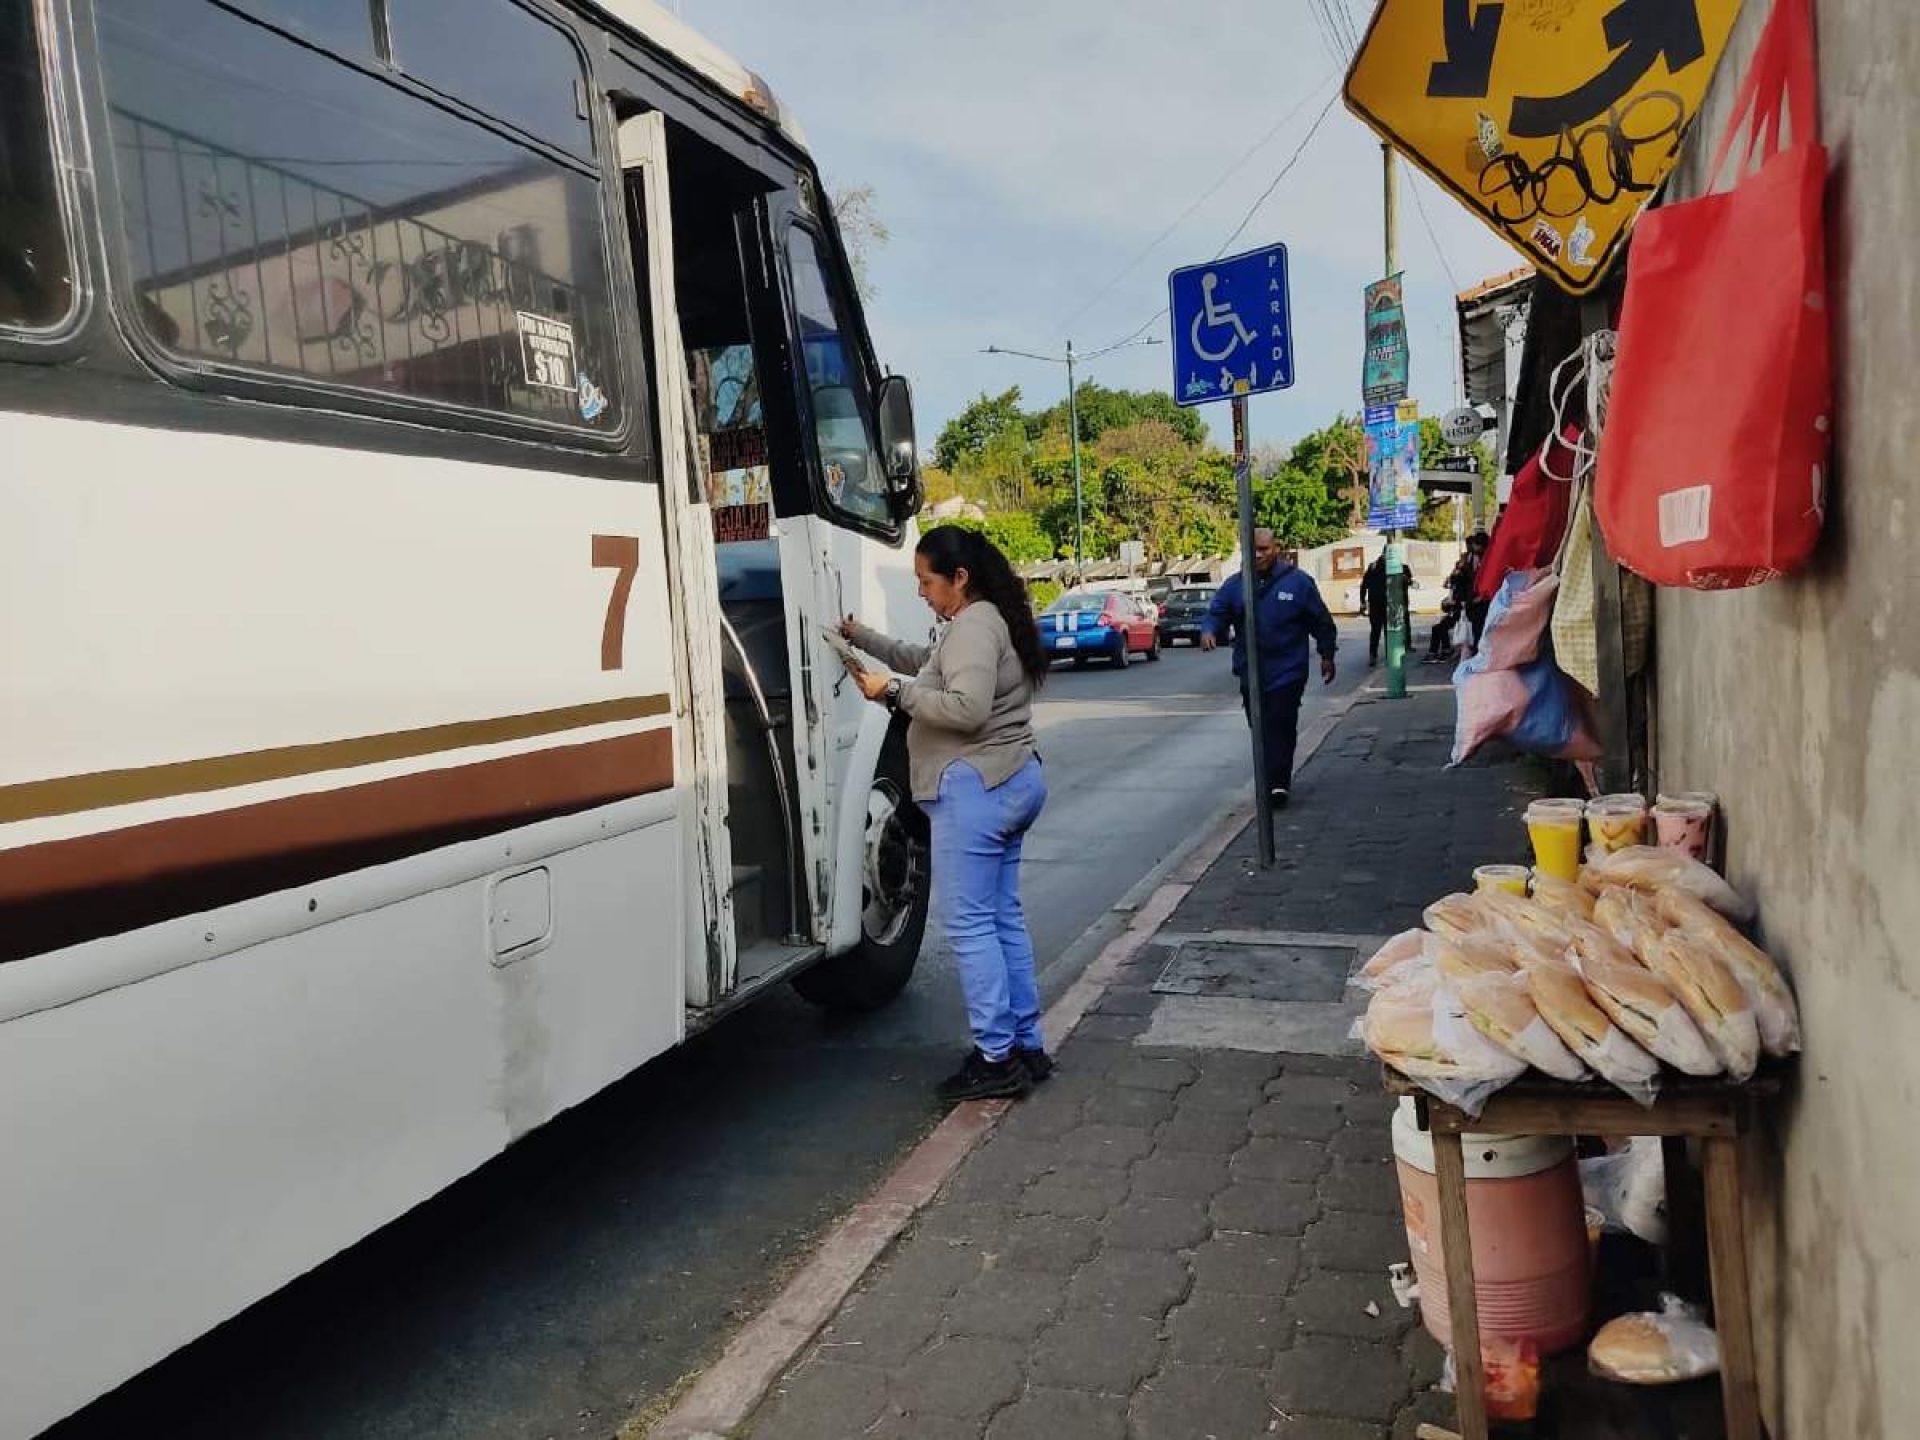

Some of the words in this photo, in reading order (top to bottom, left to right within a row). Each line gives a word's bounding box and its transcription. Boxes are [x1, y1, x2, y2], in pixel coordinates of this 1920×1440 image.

[533, 350, 566, 386] $10
[1267, 254, 1286, 386] PARADA
[591, 533, 639, 672] 7
